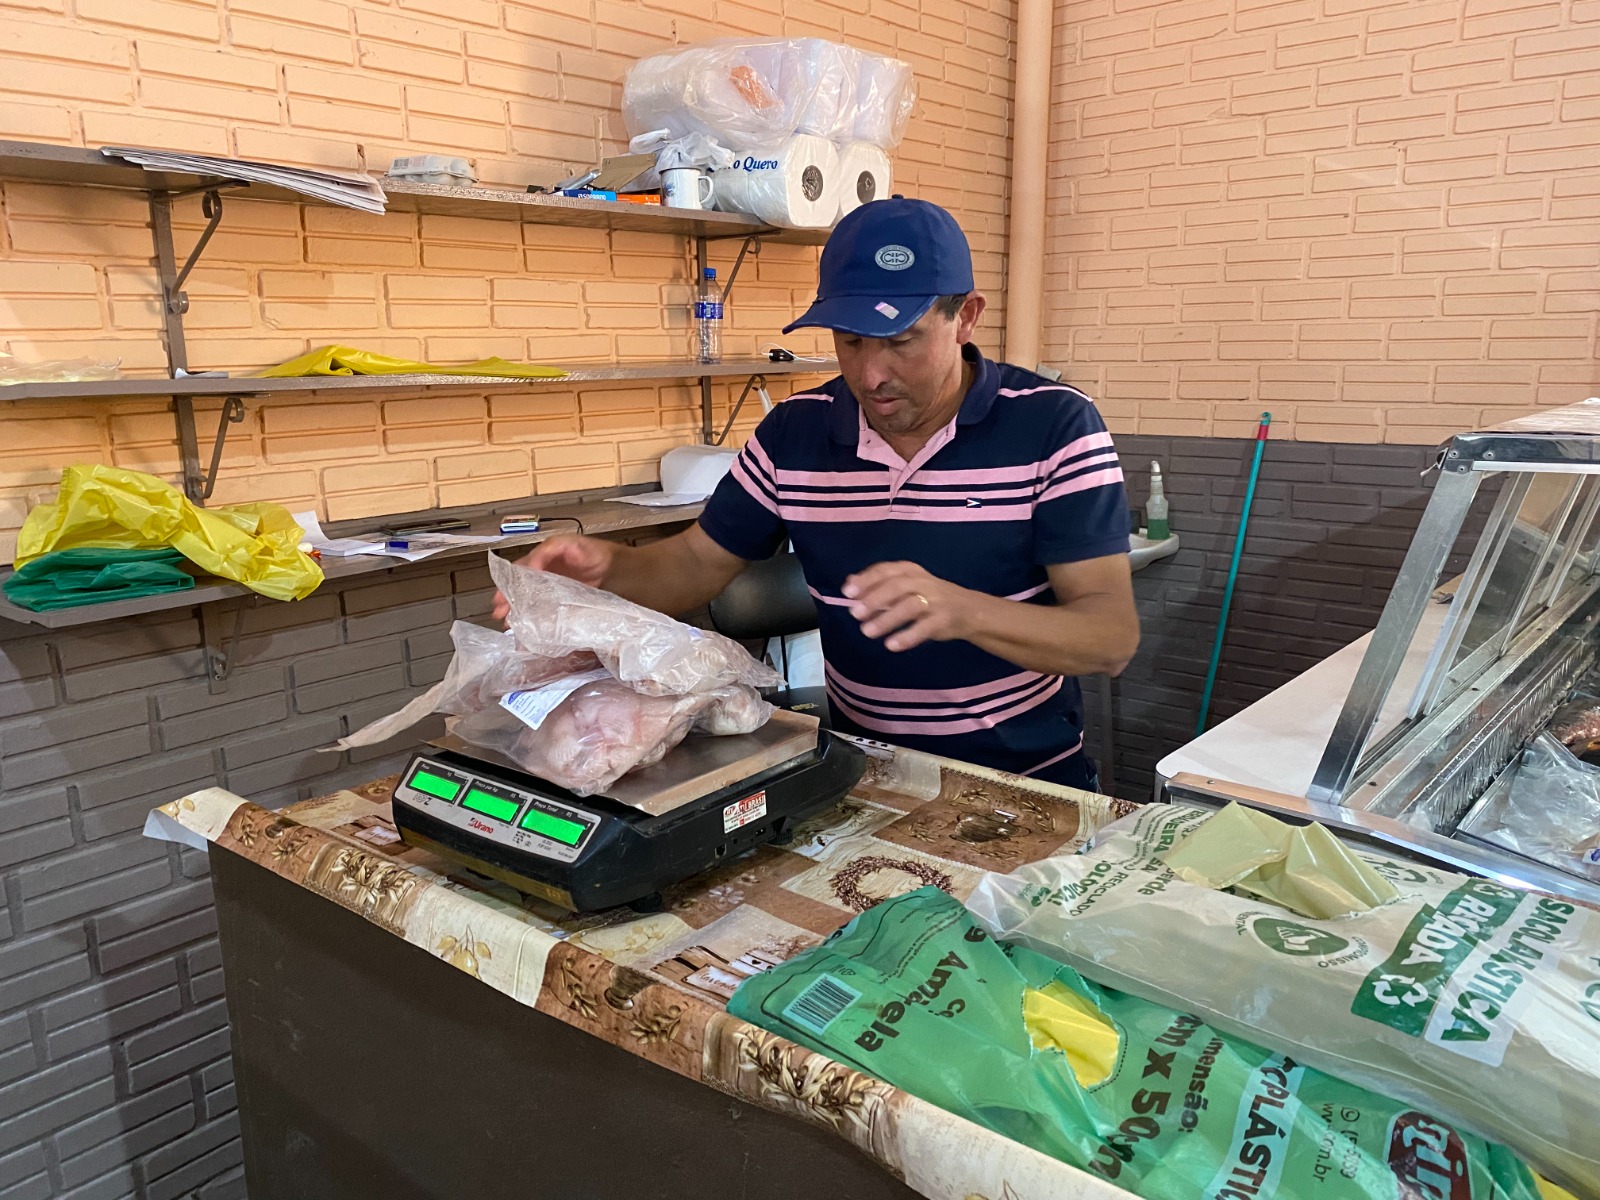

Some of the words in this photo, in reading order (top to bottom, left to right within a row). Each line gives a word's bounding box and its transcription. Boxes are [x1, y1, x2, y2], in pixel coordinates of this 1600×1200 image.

[743, 156, 778, 172] Quero
[474, 819, 494, 834] Urano
[1070, 871, 1129, 917] RECICLADO
[1142, 1047, 1177, 1080] x
